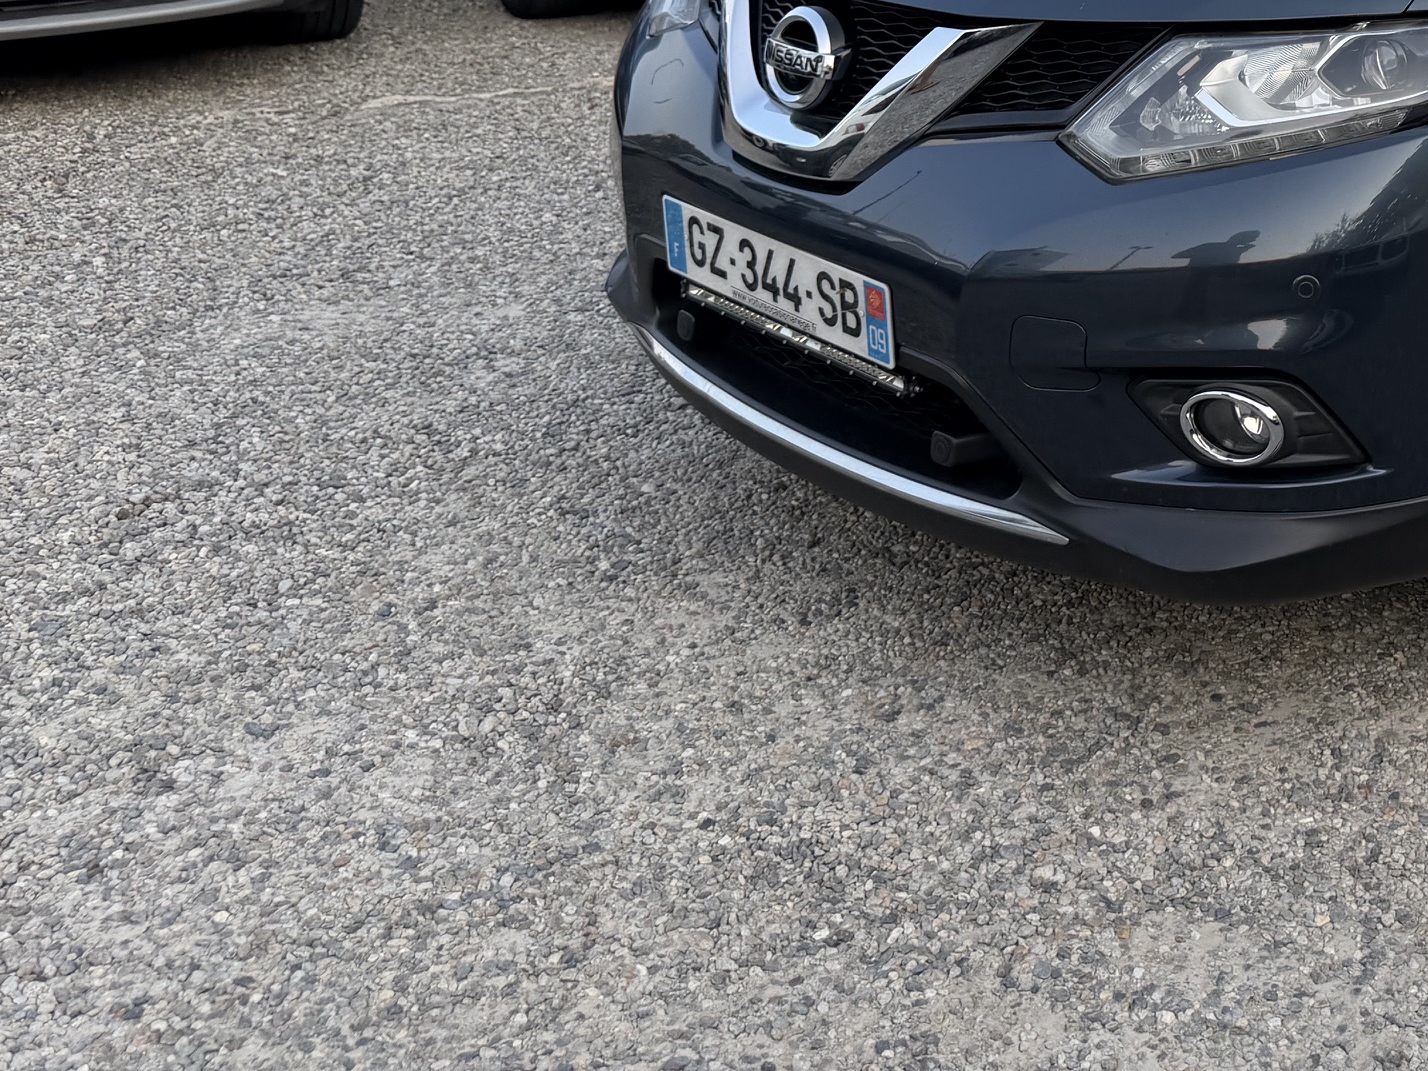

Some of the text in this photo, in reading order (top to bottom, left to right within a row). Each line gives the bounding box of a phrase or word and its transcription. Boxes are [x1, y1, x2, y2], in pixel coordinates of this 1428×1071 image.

[673, 241, 680, 257] F
[687, 215, 862, 338] GZ-344-SB
[869, 324, 887, 354] 09
